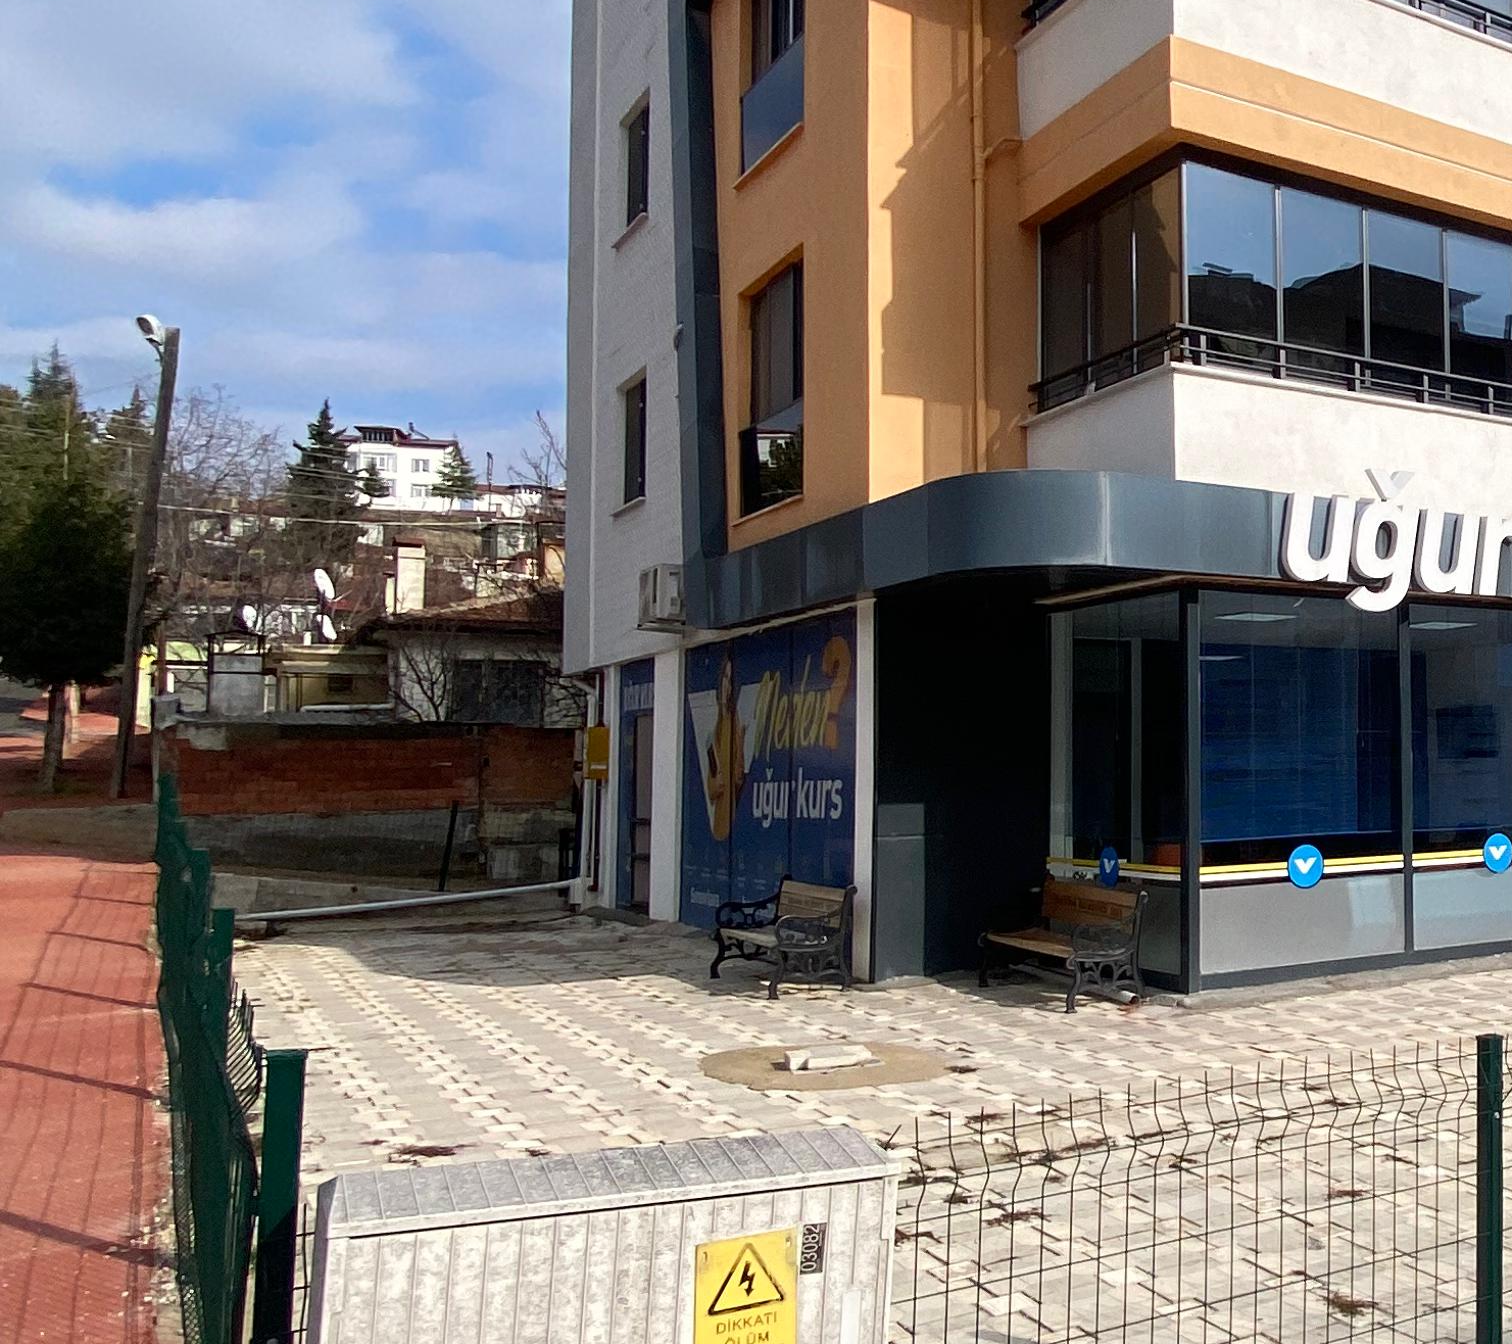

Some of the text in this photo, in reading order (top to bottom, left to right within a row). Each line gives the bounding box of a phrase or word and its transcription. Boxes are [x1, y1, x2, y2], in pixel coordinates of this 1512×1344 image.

[752, 767, 844, 829] uğur kurs
[801, 1224, 821, 1273] 03082
